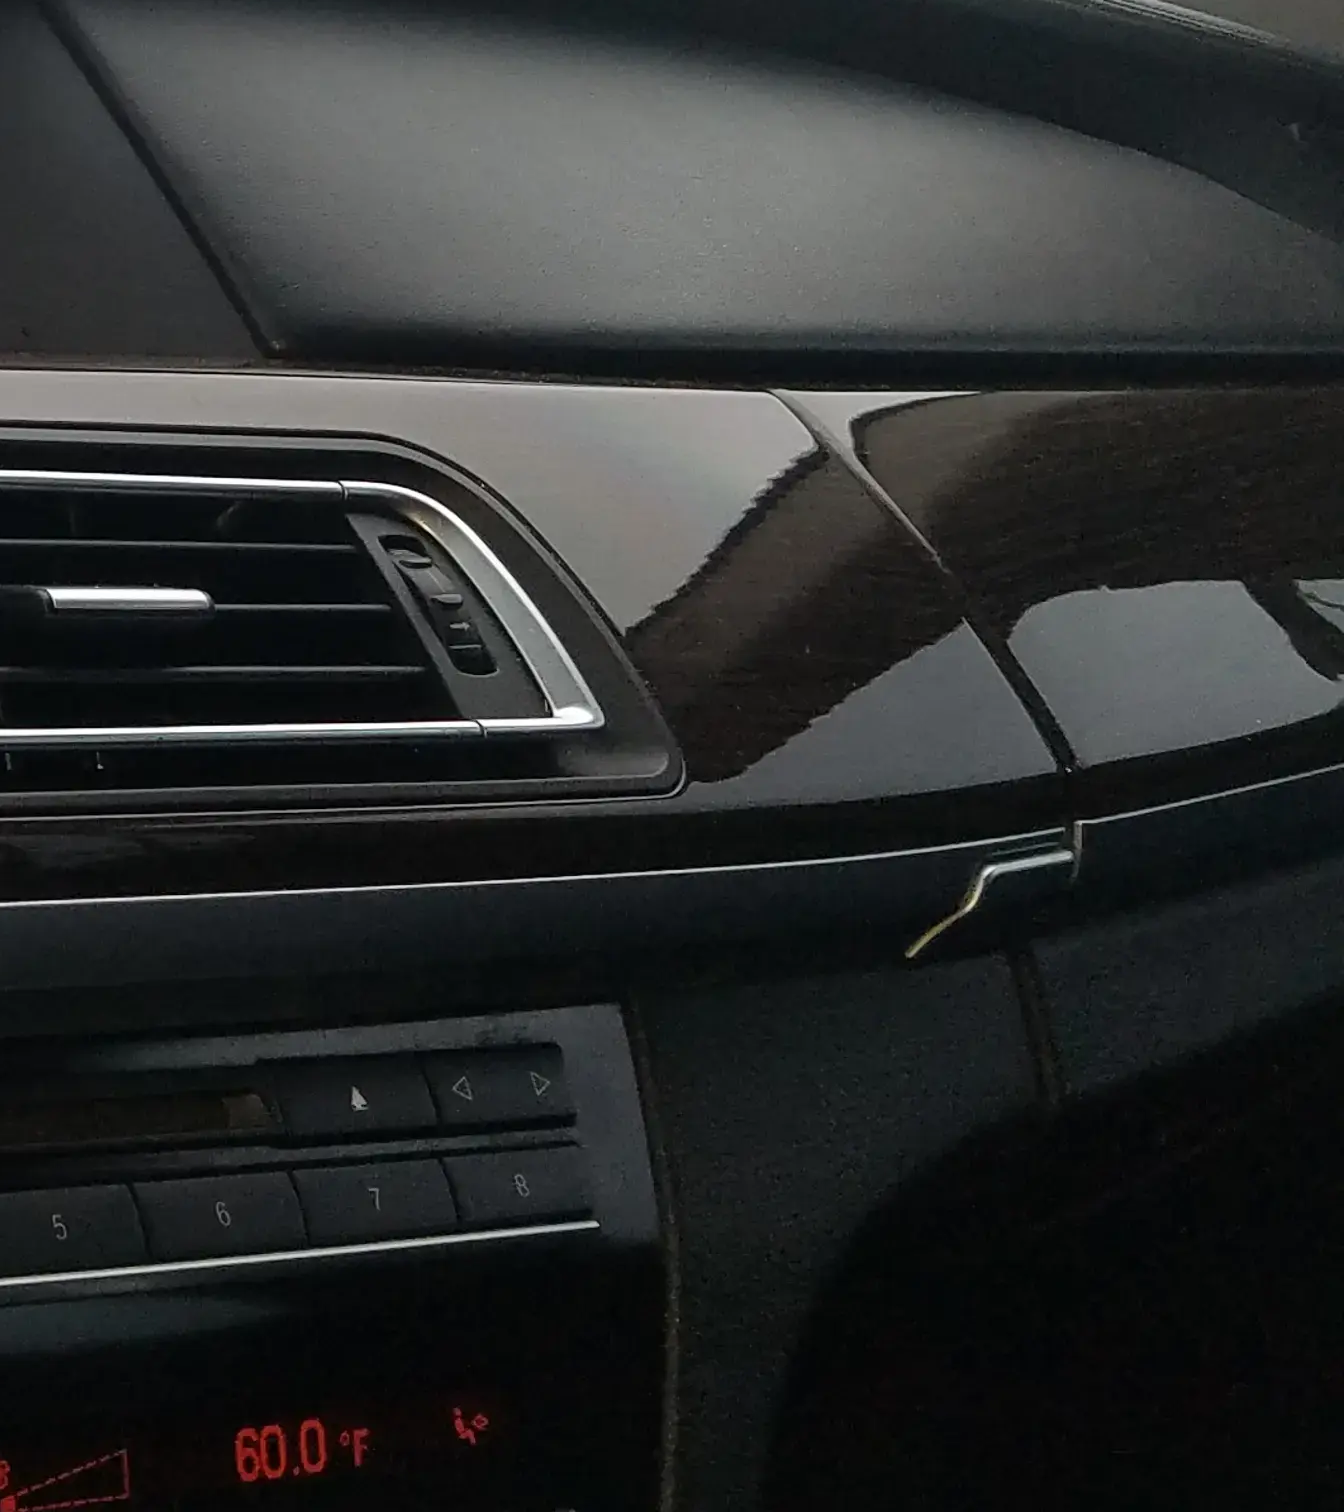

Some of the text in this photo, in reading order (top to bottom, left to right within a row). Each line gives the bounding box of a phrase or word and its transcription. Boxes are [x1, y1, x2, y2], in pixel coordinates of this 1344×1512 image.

[52, 1213, 68, 1242] 5
[214, 1201, 232, 1229] 6
[367, 1186, 383, 1212] 7
[513, 1173, 530, 1199] 8
[234, 1418, 371, 1482] 60.0 °F
